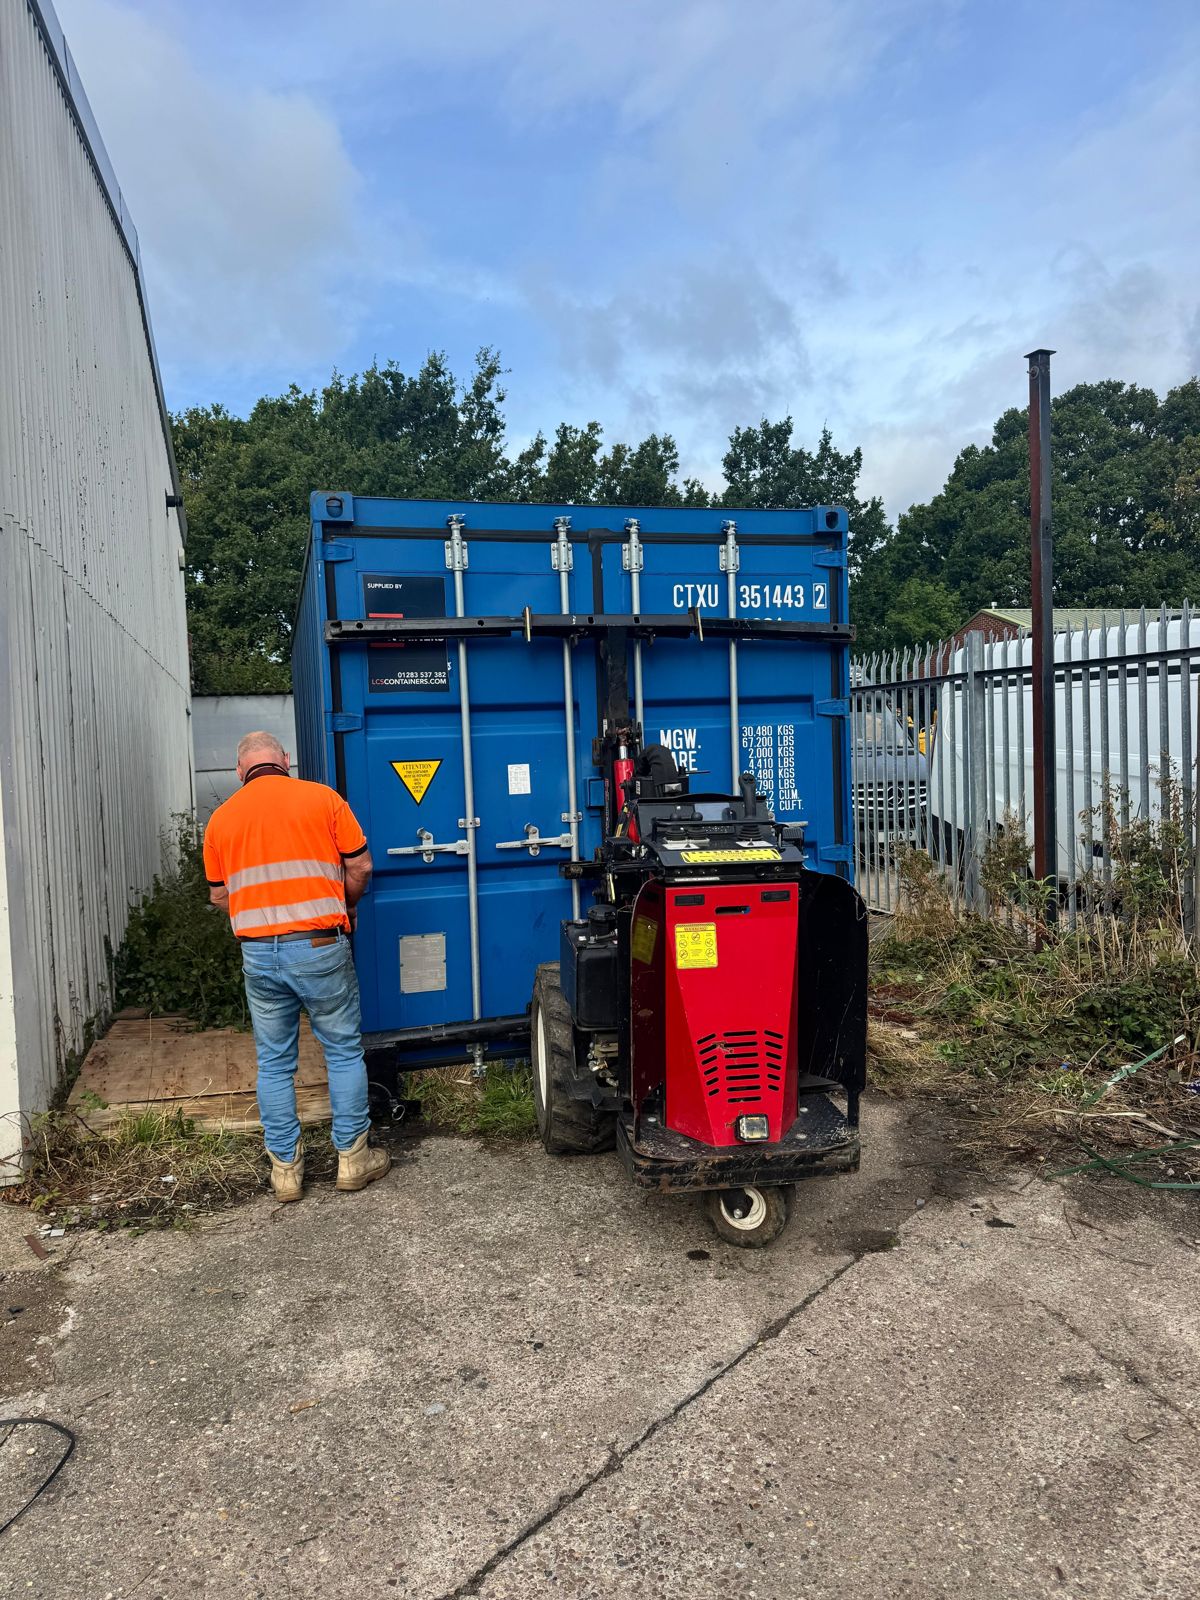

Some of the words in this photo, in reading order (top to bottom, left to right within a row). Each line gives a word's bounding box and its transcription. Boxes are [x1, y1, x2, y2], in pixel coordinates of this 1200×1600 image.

[673, 584, 719, 608] CTXU
[739, 585, 804, 608] 351443
[814, 584, 826, 608] 2
[777, 724, 795, 736] KGS
[660, 728, 702, 750] MGW.
[777, 735, 795, 747] LBS
[777, 746, 795, 757] KGS
[778, 756, 795, 768] LBS
[778, 767, 796, 779] KGS
[778, 778, 796, 790] LBS
